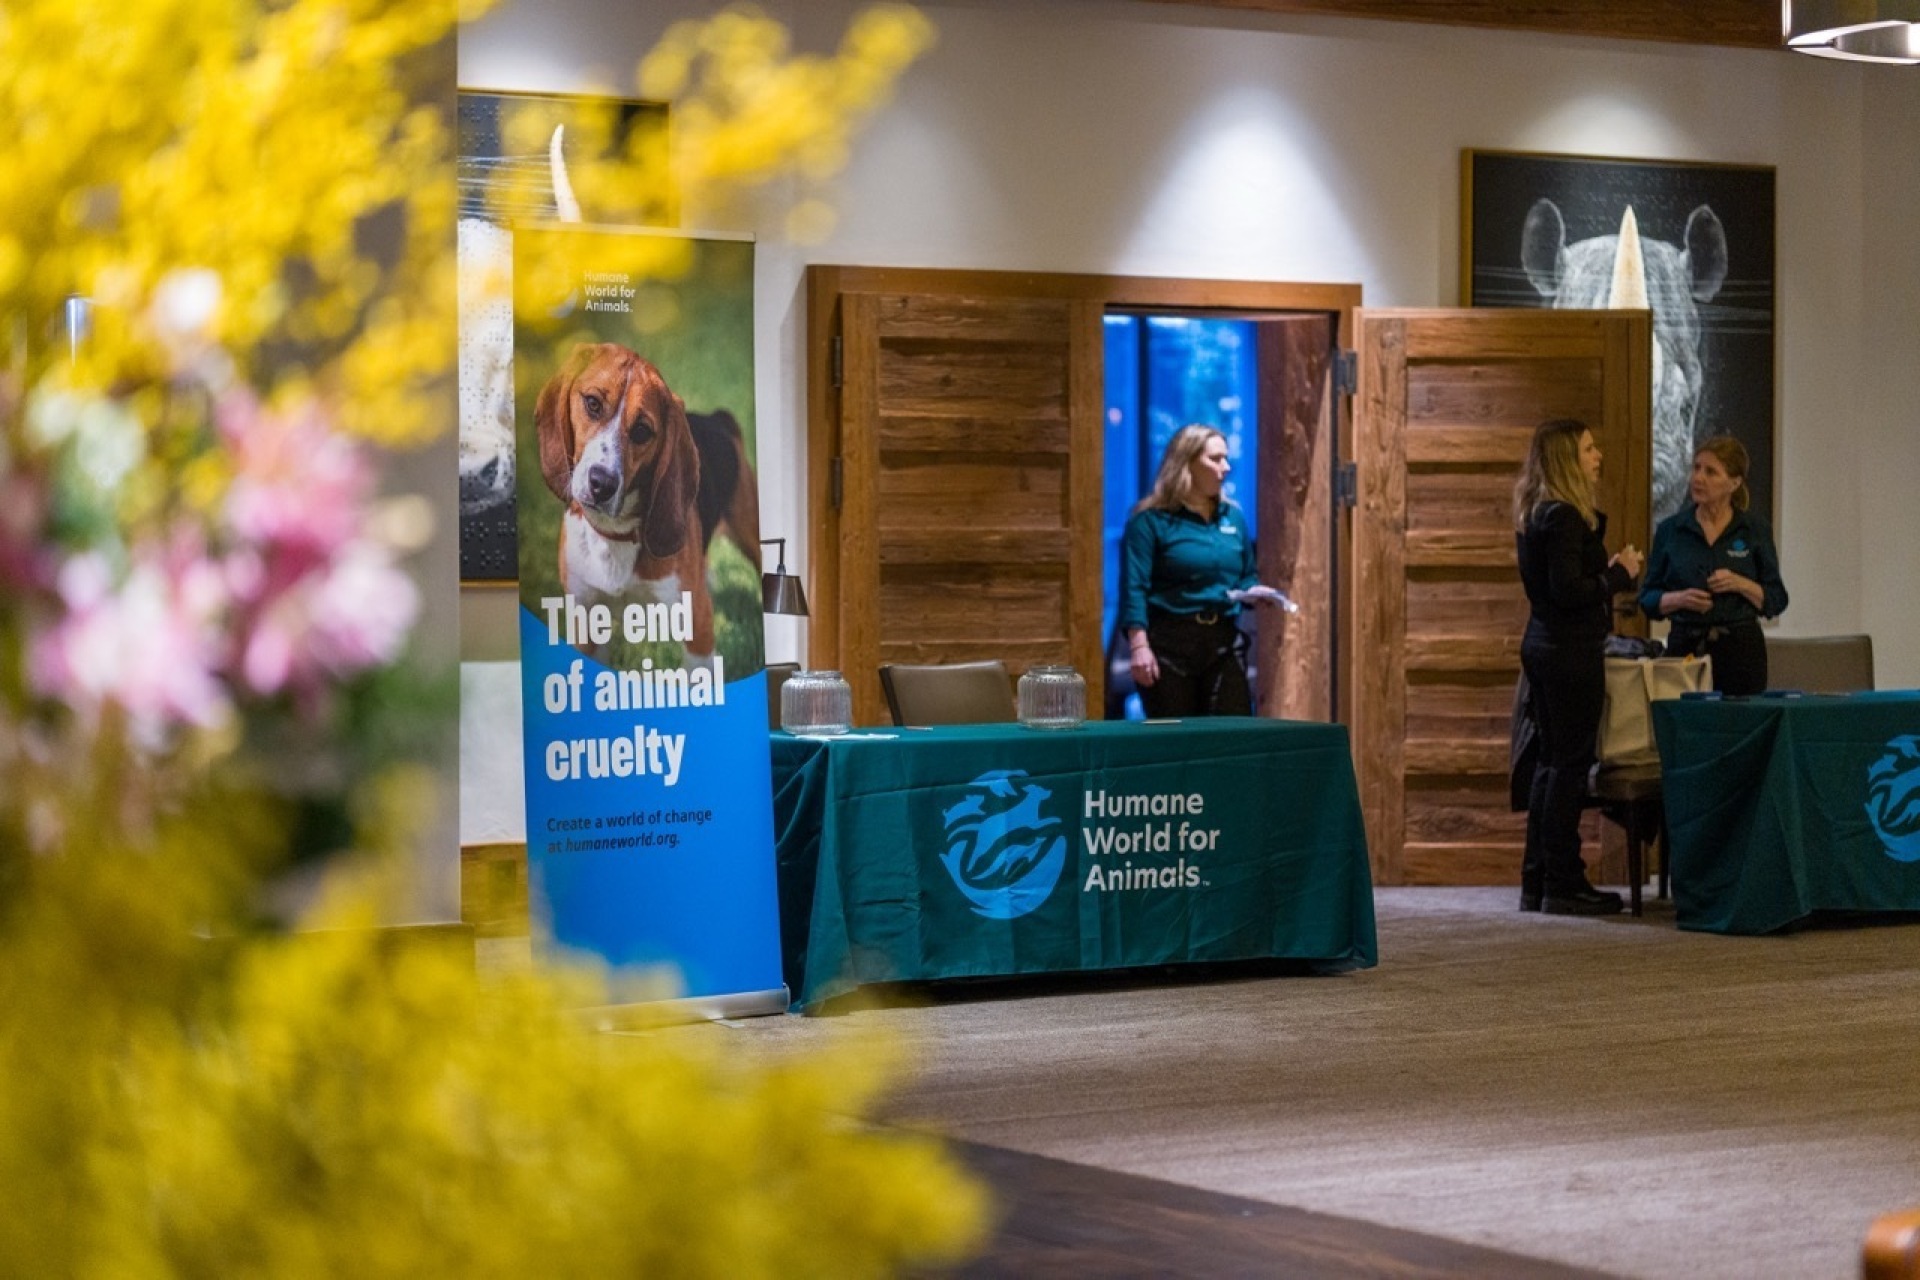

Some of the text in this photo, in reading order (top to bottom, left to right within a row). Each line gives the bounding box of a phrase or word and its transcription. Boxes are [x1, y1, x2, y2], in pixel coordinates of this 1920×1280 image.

[584, 270, 629, 283] Humane
[584, 284, 635, 298] World for
[541, 591, 693, 646] The end
[543, 655, 725, 713] of animal
[545, 724, 686, 786] cruelty
[1084, 789, 1204, 818] Humane
[546, 809, 712, 832] Create a world of change
[548, 832, 680, 853] at humaneworld.org.
[1083, 821, 1221, 855] World for
